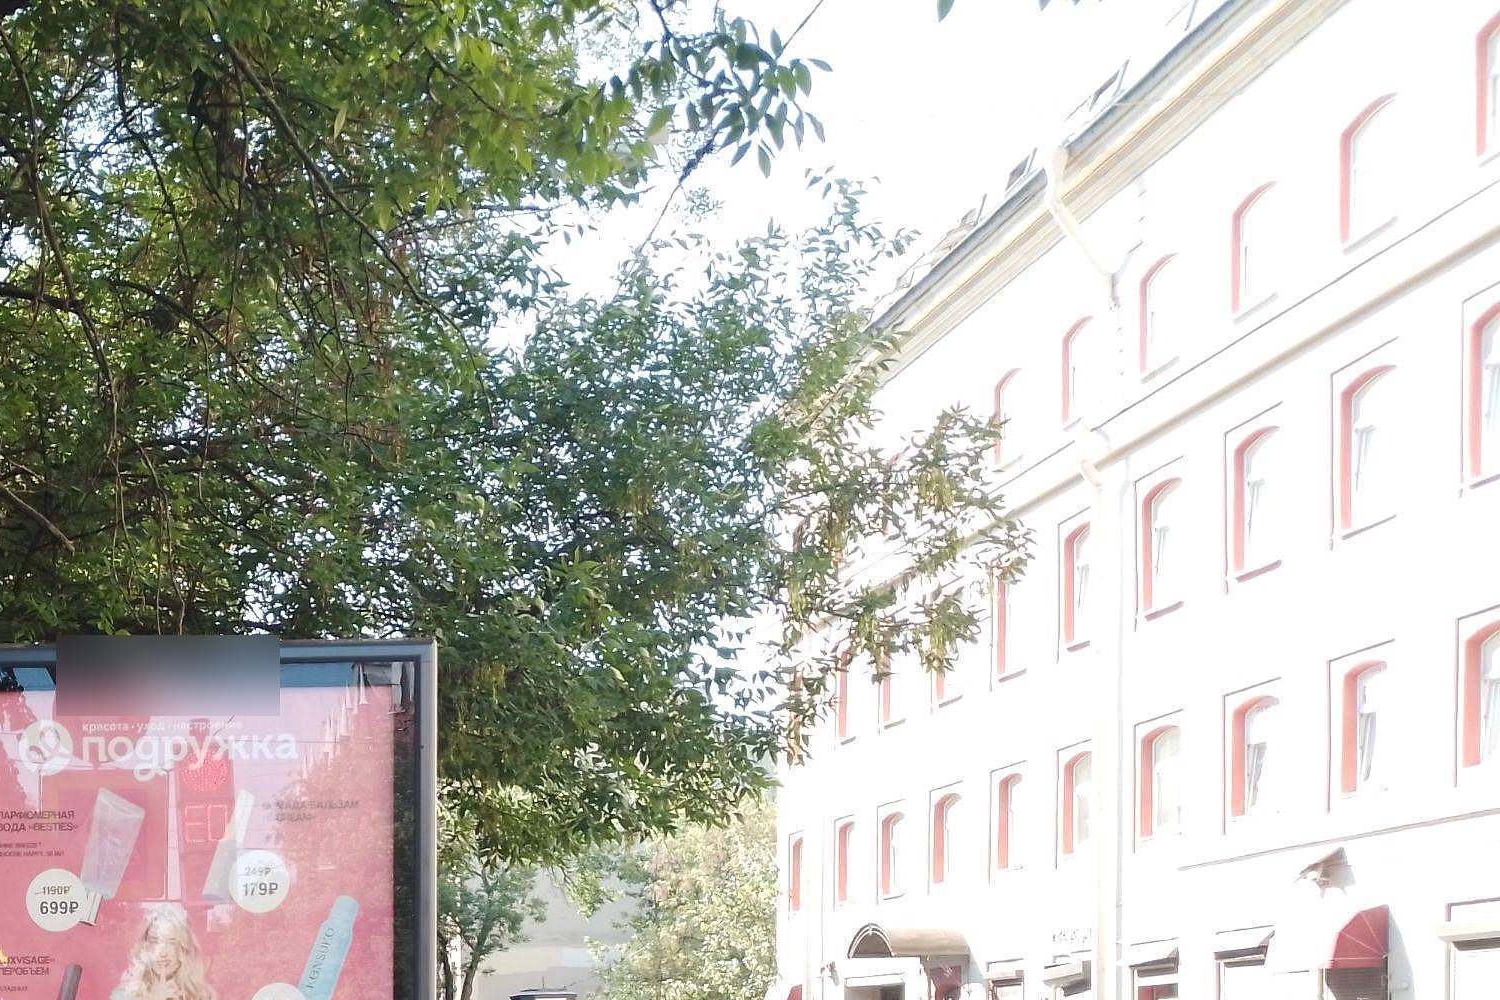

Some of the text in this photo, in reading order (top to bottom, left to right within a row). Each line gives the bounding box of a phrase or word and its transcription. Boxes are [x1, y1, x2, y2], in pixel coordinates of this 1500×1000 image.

[81, 732, 300, 782] подружка
[243, 882, 278, 896] 179₽
[40, 901, 79, 914] 699₽
